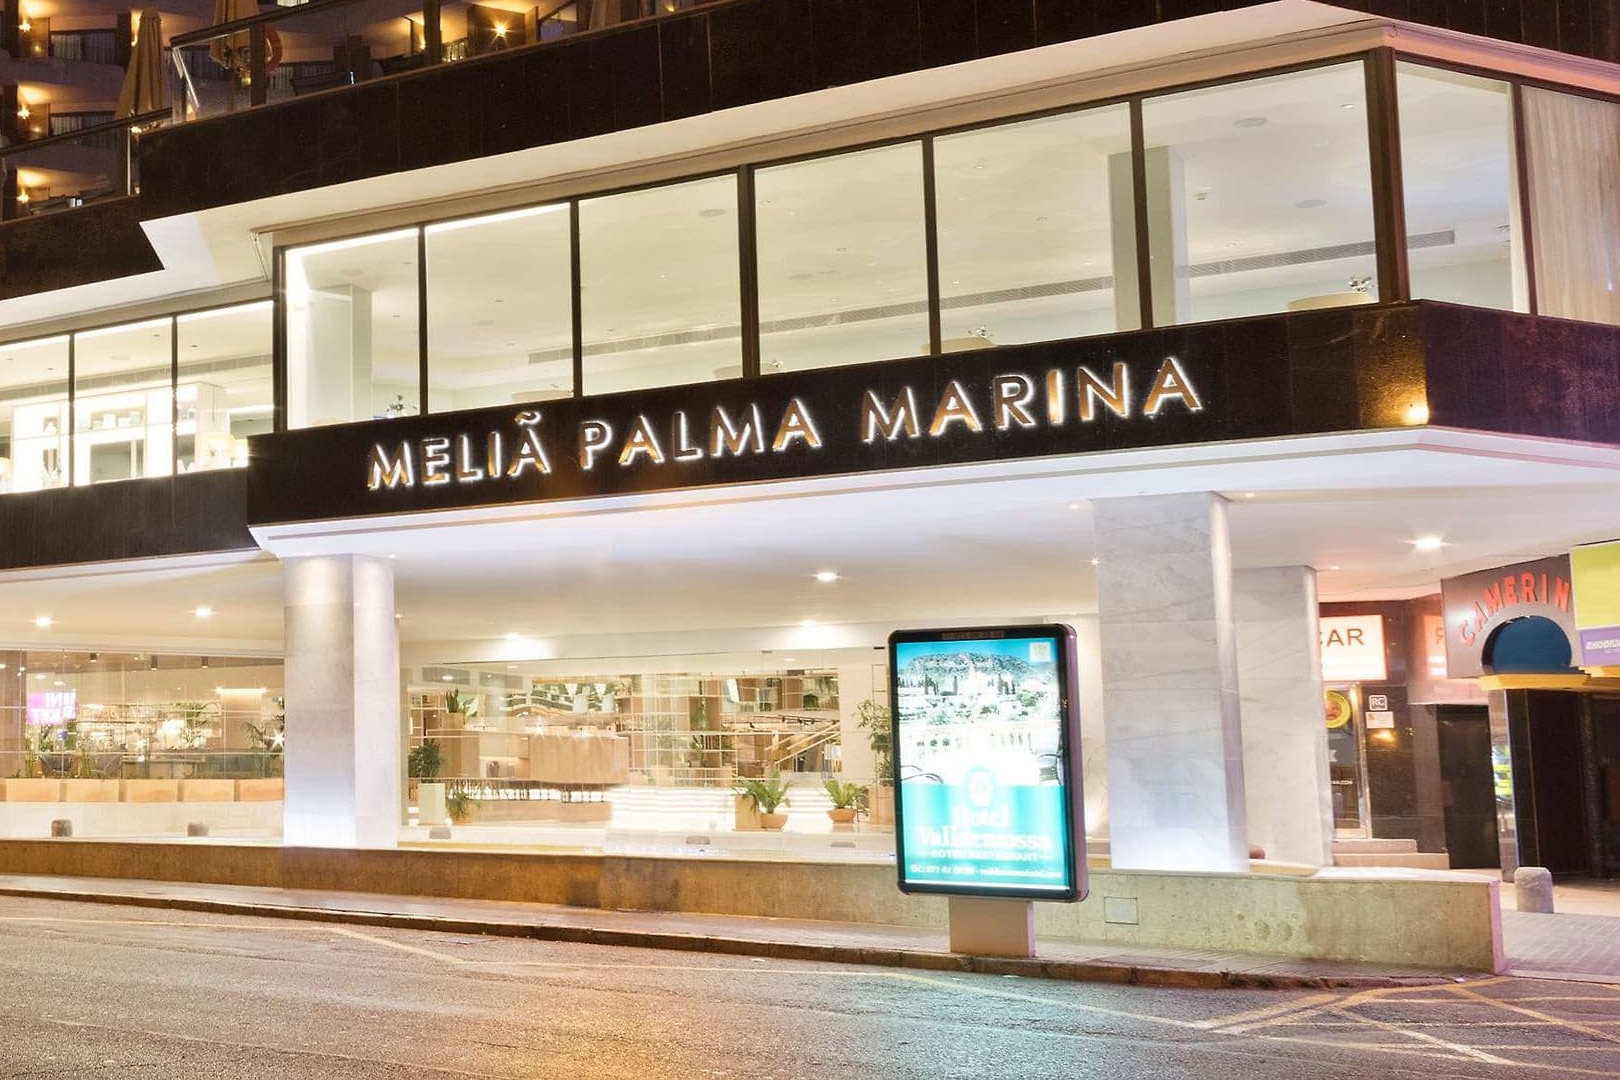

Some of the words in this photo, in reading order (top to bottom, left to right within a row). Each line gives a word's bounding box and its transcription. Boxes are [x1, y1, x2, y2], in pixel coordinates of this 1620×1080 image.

[579, 397, 823, 471] PALMA
[860, 356, 1204, 443] MARINA
[1320, 628, 1365, 647] AR
[1459, 572, 1570, 649] CAMERIN
